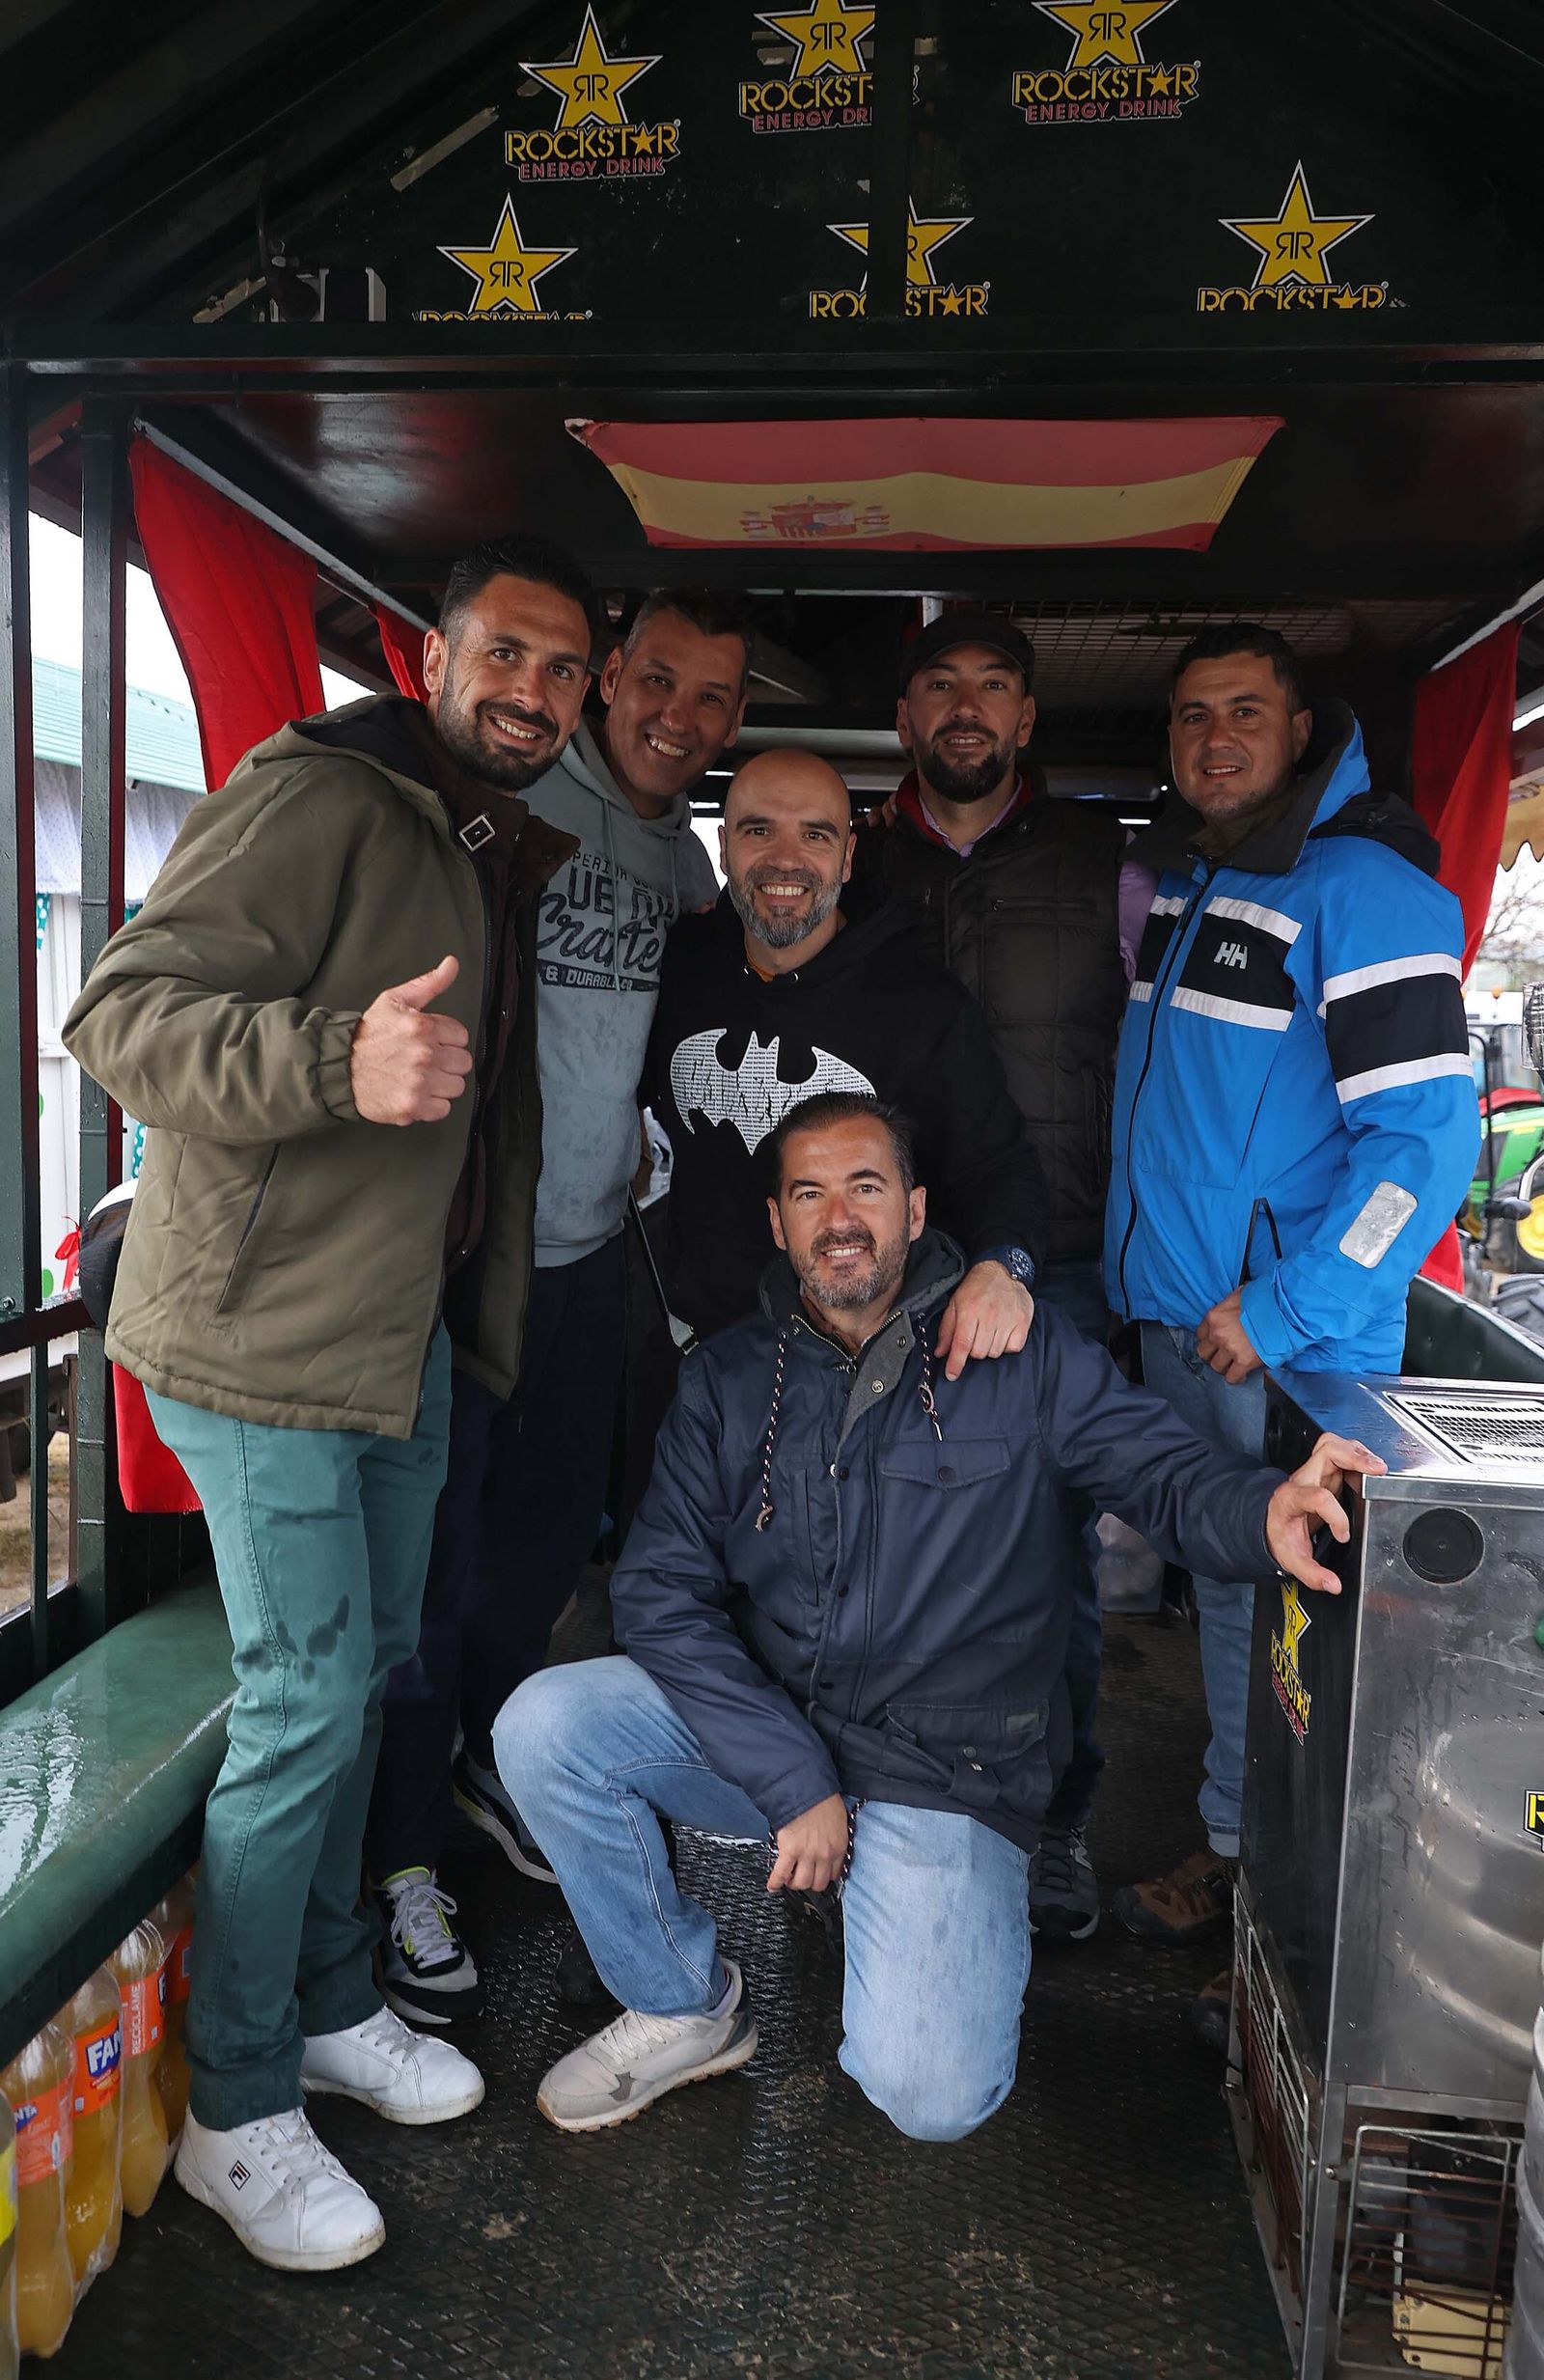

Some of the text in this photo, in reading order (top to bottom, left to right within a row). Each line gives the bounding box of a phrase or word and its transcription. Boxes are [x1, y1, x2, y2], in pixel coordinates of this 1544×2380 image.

[741, 73, 873, 114] ROCKST
[1014, 65, 1197, 104] ROCKSTAR
[755, 108, 834, 131] ENERGY
[1027, 97, 1182, 122] ENERGY DRINK
[507, 124, 677, 162] ROCKSTAR
[520, 155, 664, 180] ENERGY DRINK
[1214, 941, 1248, 970] HH
